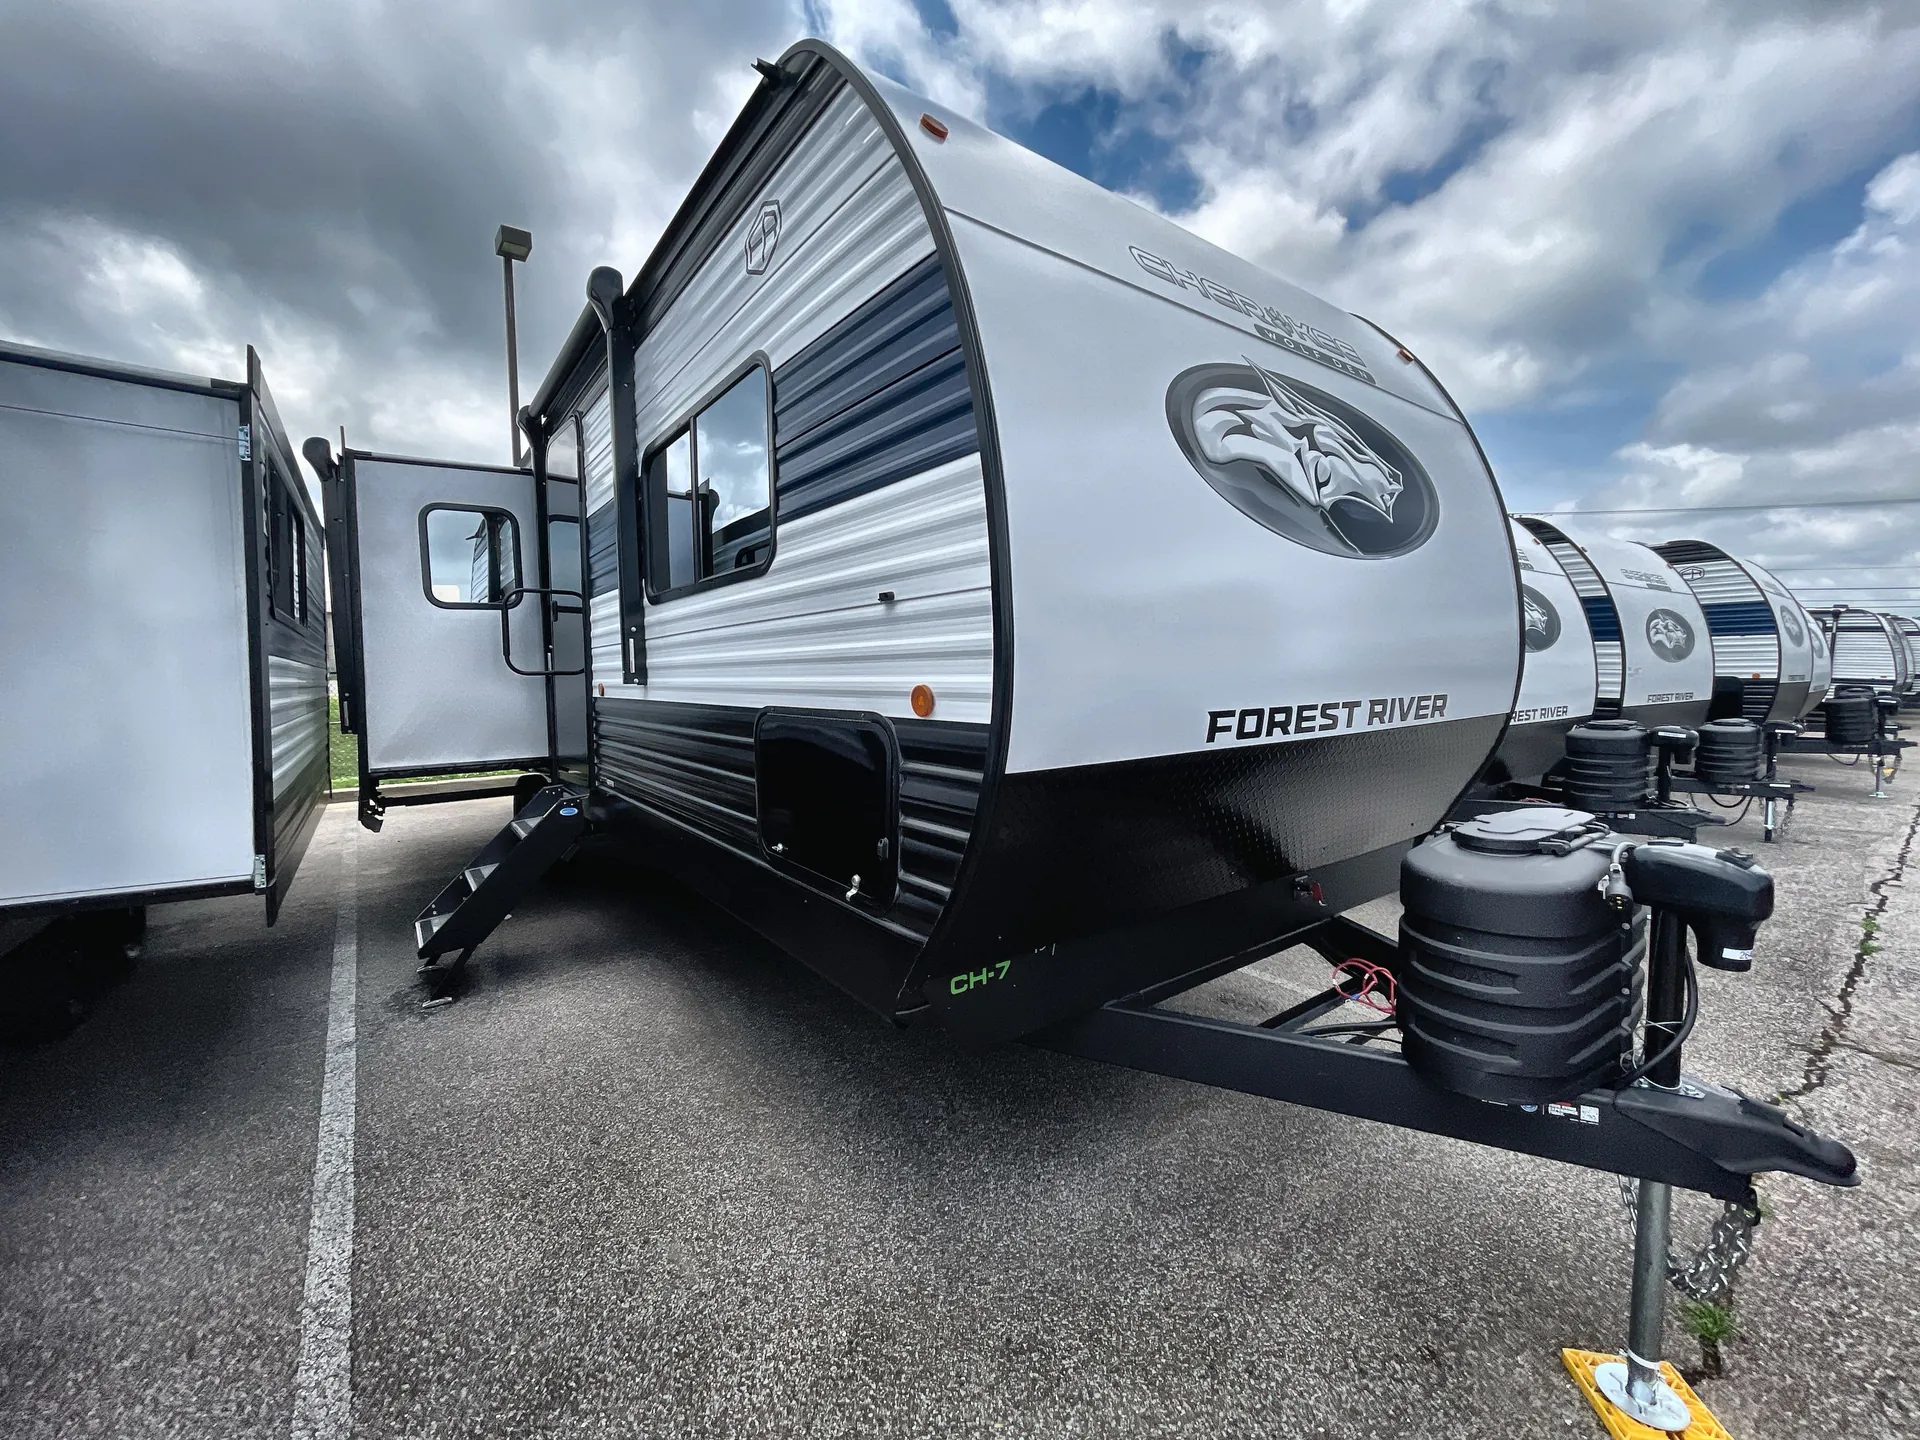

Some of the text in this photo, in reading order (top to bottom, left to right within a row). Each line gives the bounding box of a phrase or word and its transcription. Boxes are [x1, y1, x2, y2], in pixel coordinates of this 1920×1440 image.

[1264, 329, 1368, 379] WOLF DEN
[1511, 705, 1569, 723] REST RIVER
[1647, 692, 1694, 704] FOREST RIVER
[1205, 694, 1448, 743] FOREST RIVER
[950, 960, 1011, 995] CH-7
